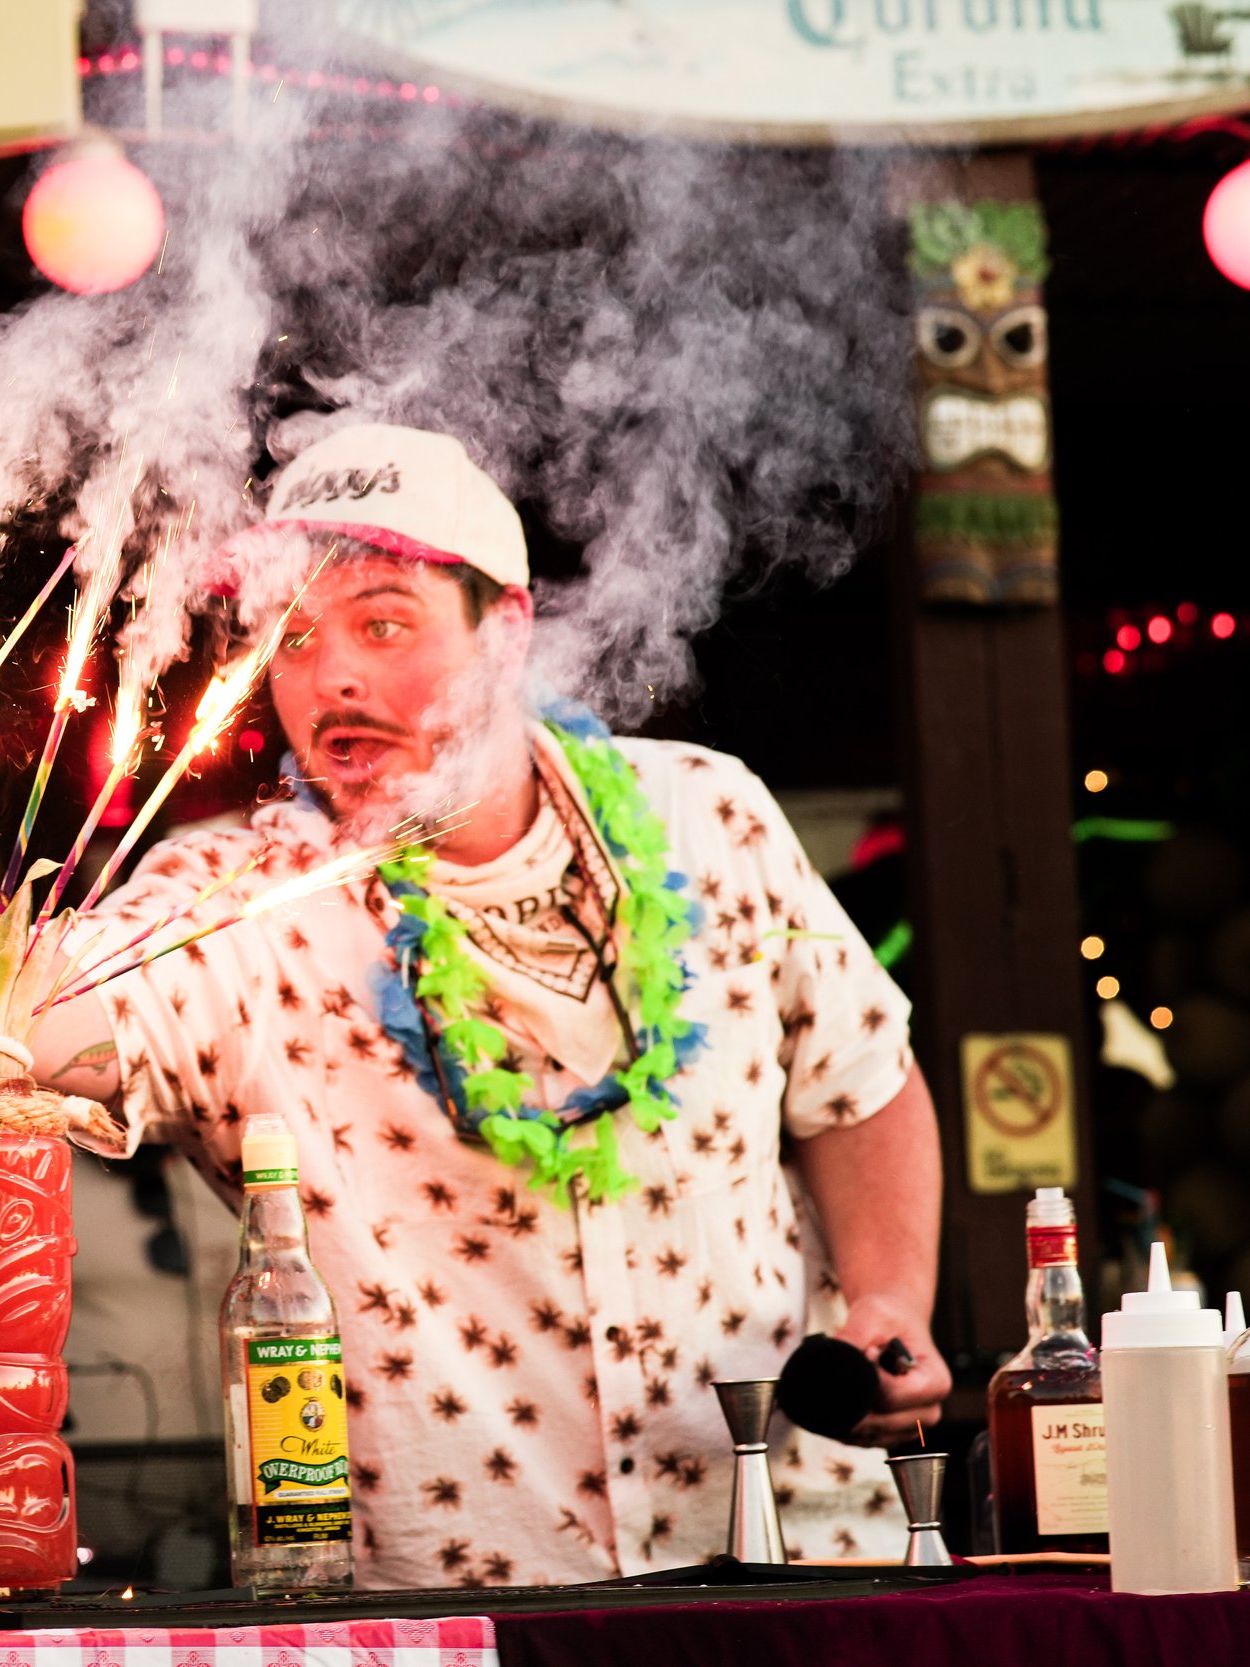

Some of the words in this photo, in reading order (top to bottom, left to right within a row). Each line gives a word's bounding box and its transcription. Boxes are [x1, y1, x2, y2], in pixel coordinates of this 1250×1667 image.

[892, 49, 1037, 101] Extra
[257, 1346, 293, 1358] WRAY
[295, 1345, 307, 1357] &
[280, 1436, 340, 1456] White
[266, 1516, 276, 1524] J.
[276, 1514, 305, 1523] WRAY
[306, 1514, 316, 1522] &
